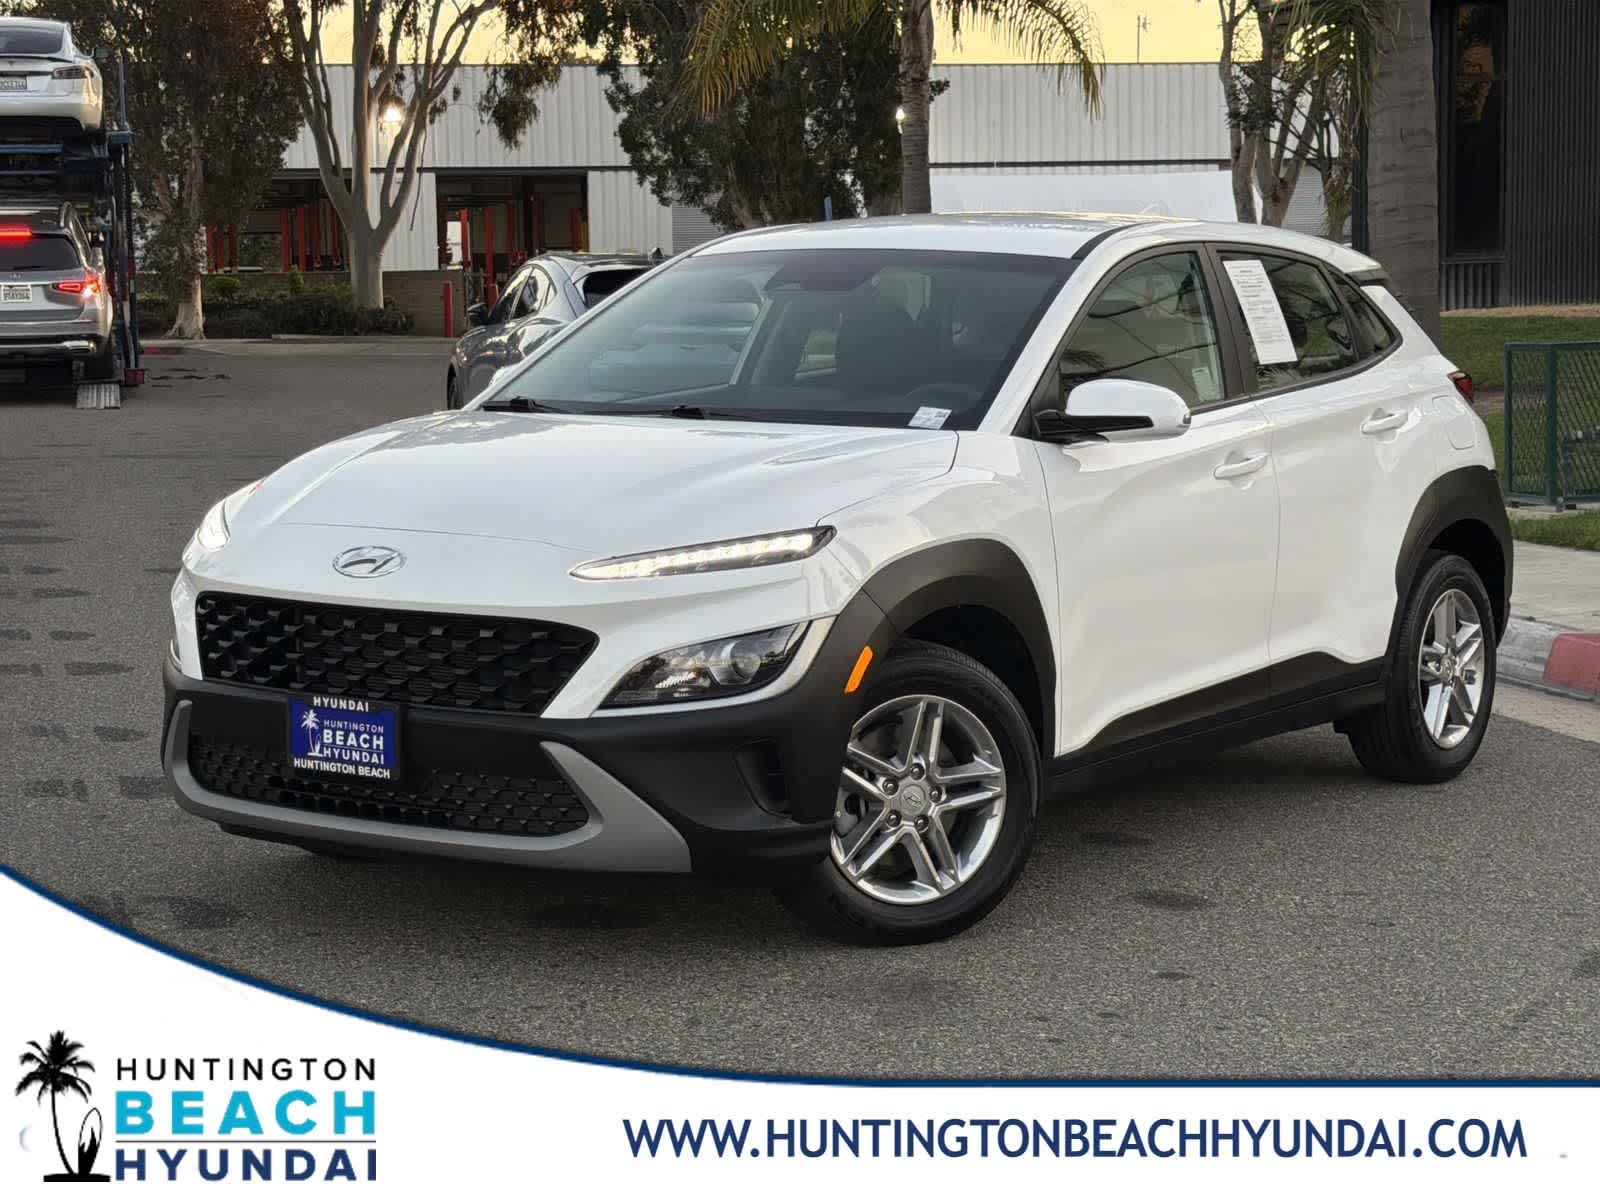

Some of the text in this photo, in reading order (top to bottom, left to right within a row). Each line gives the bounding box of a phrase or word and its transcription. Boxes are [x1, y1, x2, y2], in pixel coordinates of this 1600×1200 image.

[313, 696, 369, 712] HYUNDAI
[323, 720, 384, 733] HUNTINGTON
[323, 729, 384, 750] BEACH
[323, 747, 385, 765] HYUNDAI
[294, 758, 391, 779] HUNTINGTON BEACH
